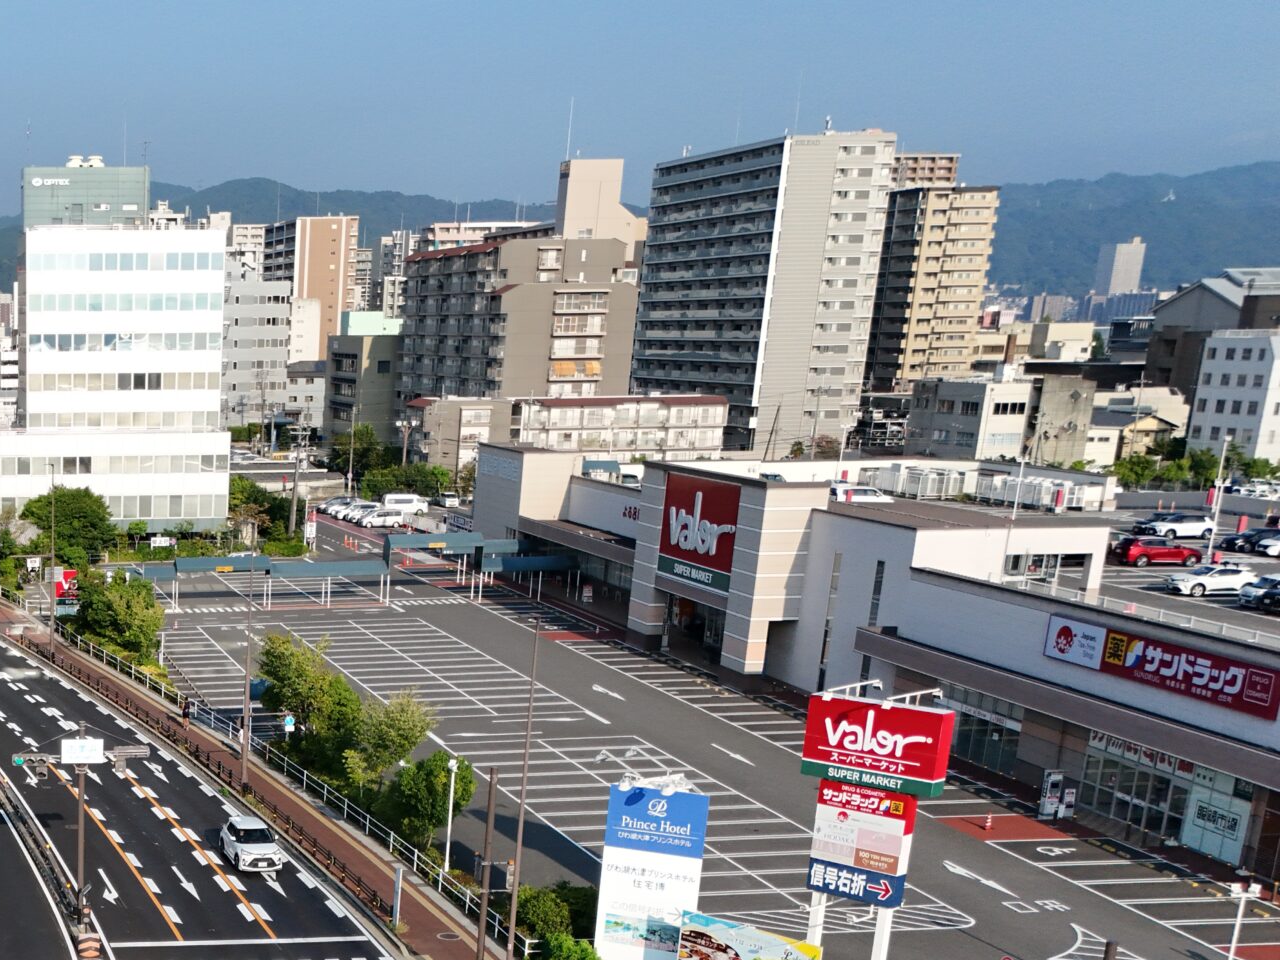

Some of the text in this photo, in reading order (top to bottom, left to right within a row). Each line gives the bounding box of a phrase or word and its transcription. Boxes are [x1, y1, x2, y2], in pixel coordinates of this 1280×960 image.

[43, 178, 70, 186] OPTEX
[673, 563, 713, 584] SUPER MARKET
[1107, 634, 1125, 662] 薬
[1144, 645, 1246, 695] サンドラッグ
[1252, 675, 1269, 684] DRUG
[825, 709, 933, 757] valor
[830, 752, 905, 773] スーパーマーケット
[828, 767, 903, 789] SUPER MARKET
[823, 788, 879, 808] サンドラッグ
[859, 788, 886, 798] COSMETIC
[621, 816, 690, 835] Prince Hotel
[618, 831, 692, 847] びわ湖大津プリンスホテル
[607, 863, 695, 883] びわ湖大津プリンスホテル
[810, 863, 867, 896] 信号右折
[633, 879, 665, 891] 住宅博
